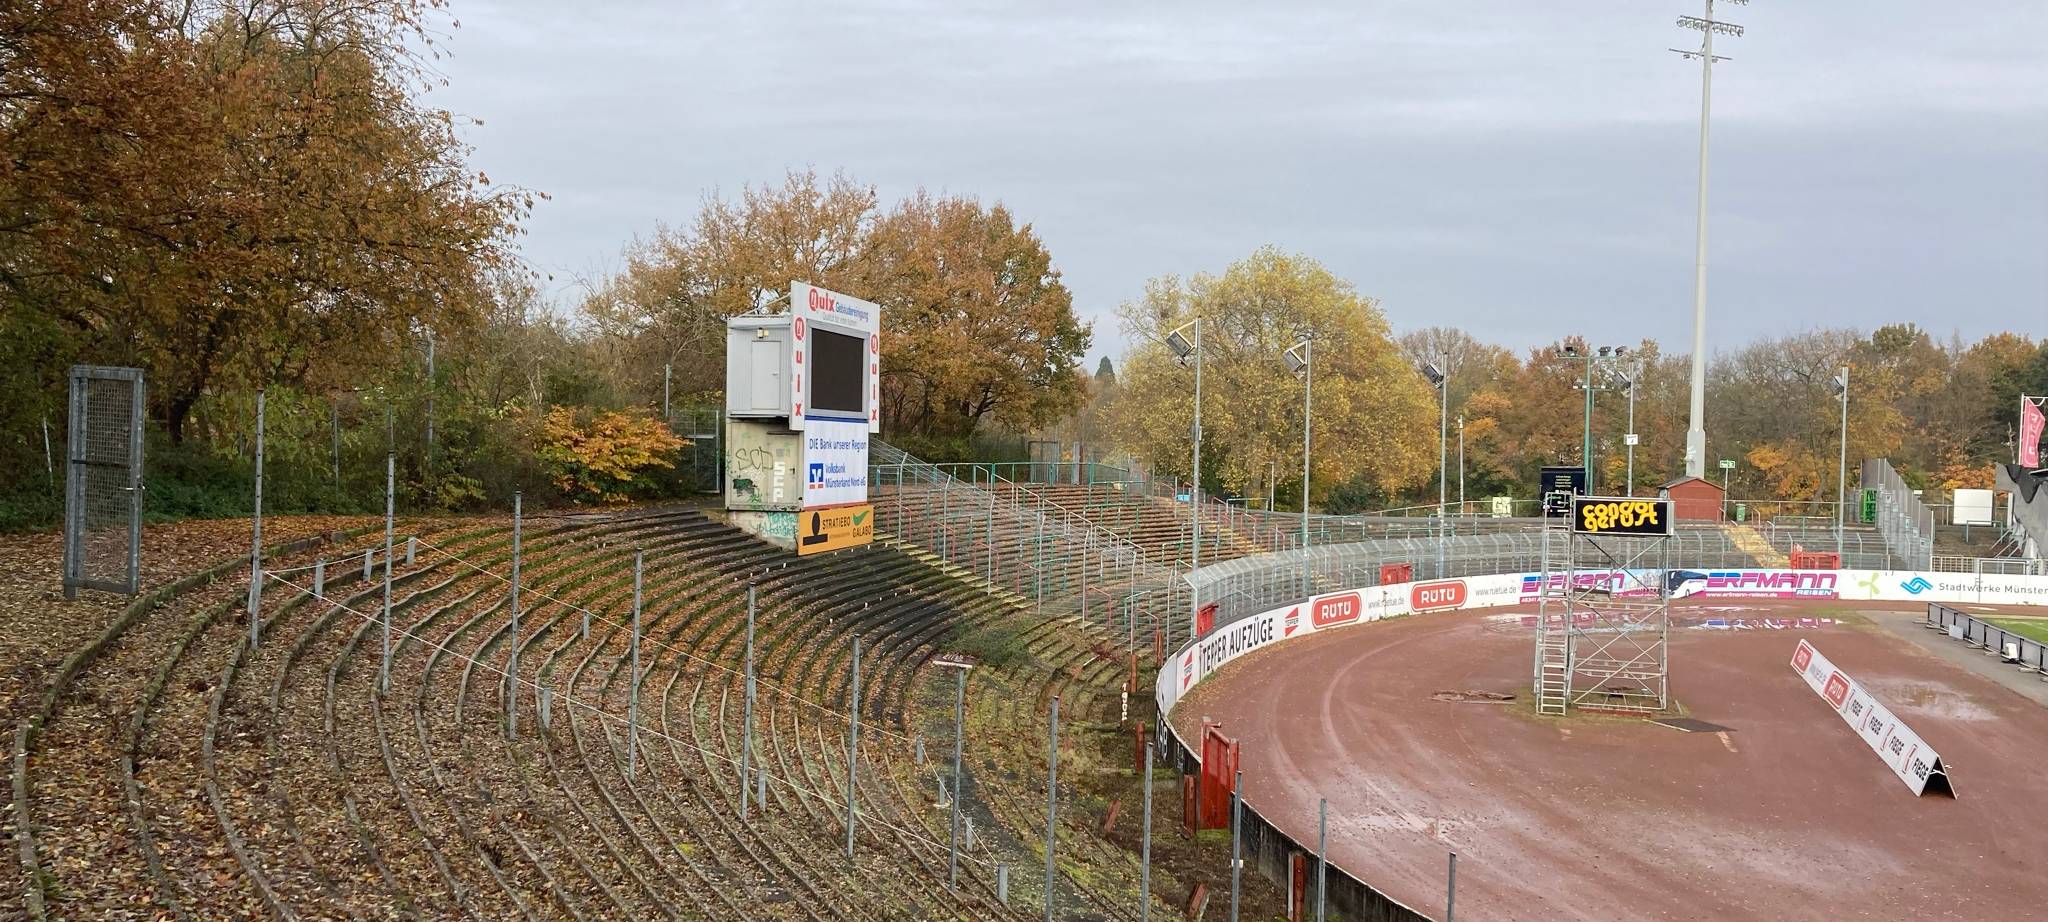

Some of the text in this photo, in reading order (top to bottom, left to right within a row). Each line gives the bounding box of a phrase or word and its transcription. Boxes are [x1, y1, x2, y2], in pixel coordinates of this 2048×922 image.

[809, 438, 819, 450] DIE
[820, 438, 832, 450] Bank
[851, 439, 867, 453] Region
[825, 463, 846, 474] Volksbank
[1706, 572, 1837, 588] ERFMANN
[1939, 582, 2001, 593] Stadtwerke
[1202, 616, 1273, 674] TEPPER AUFZÜGE
[1912, 757, 1929, 781] FIEGE
